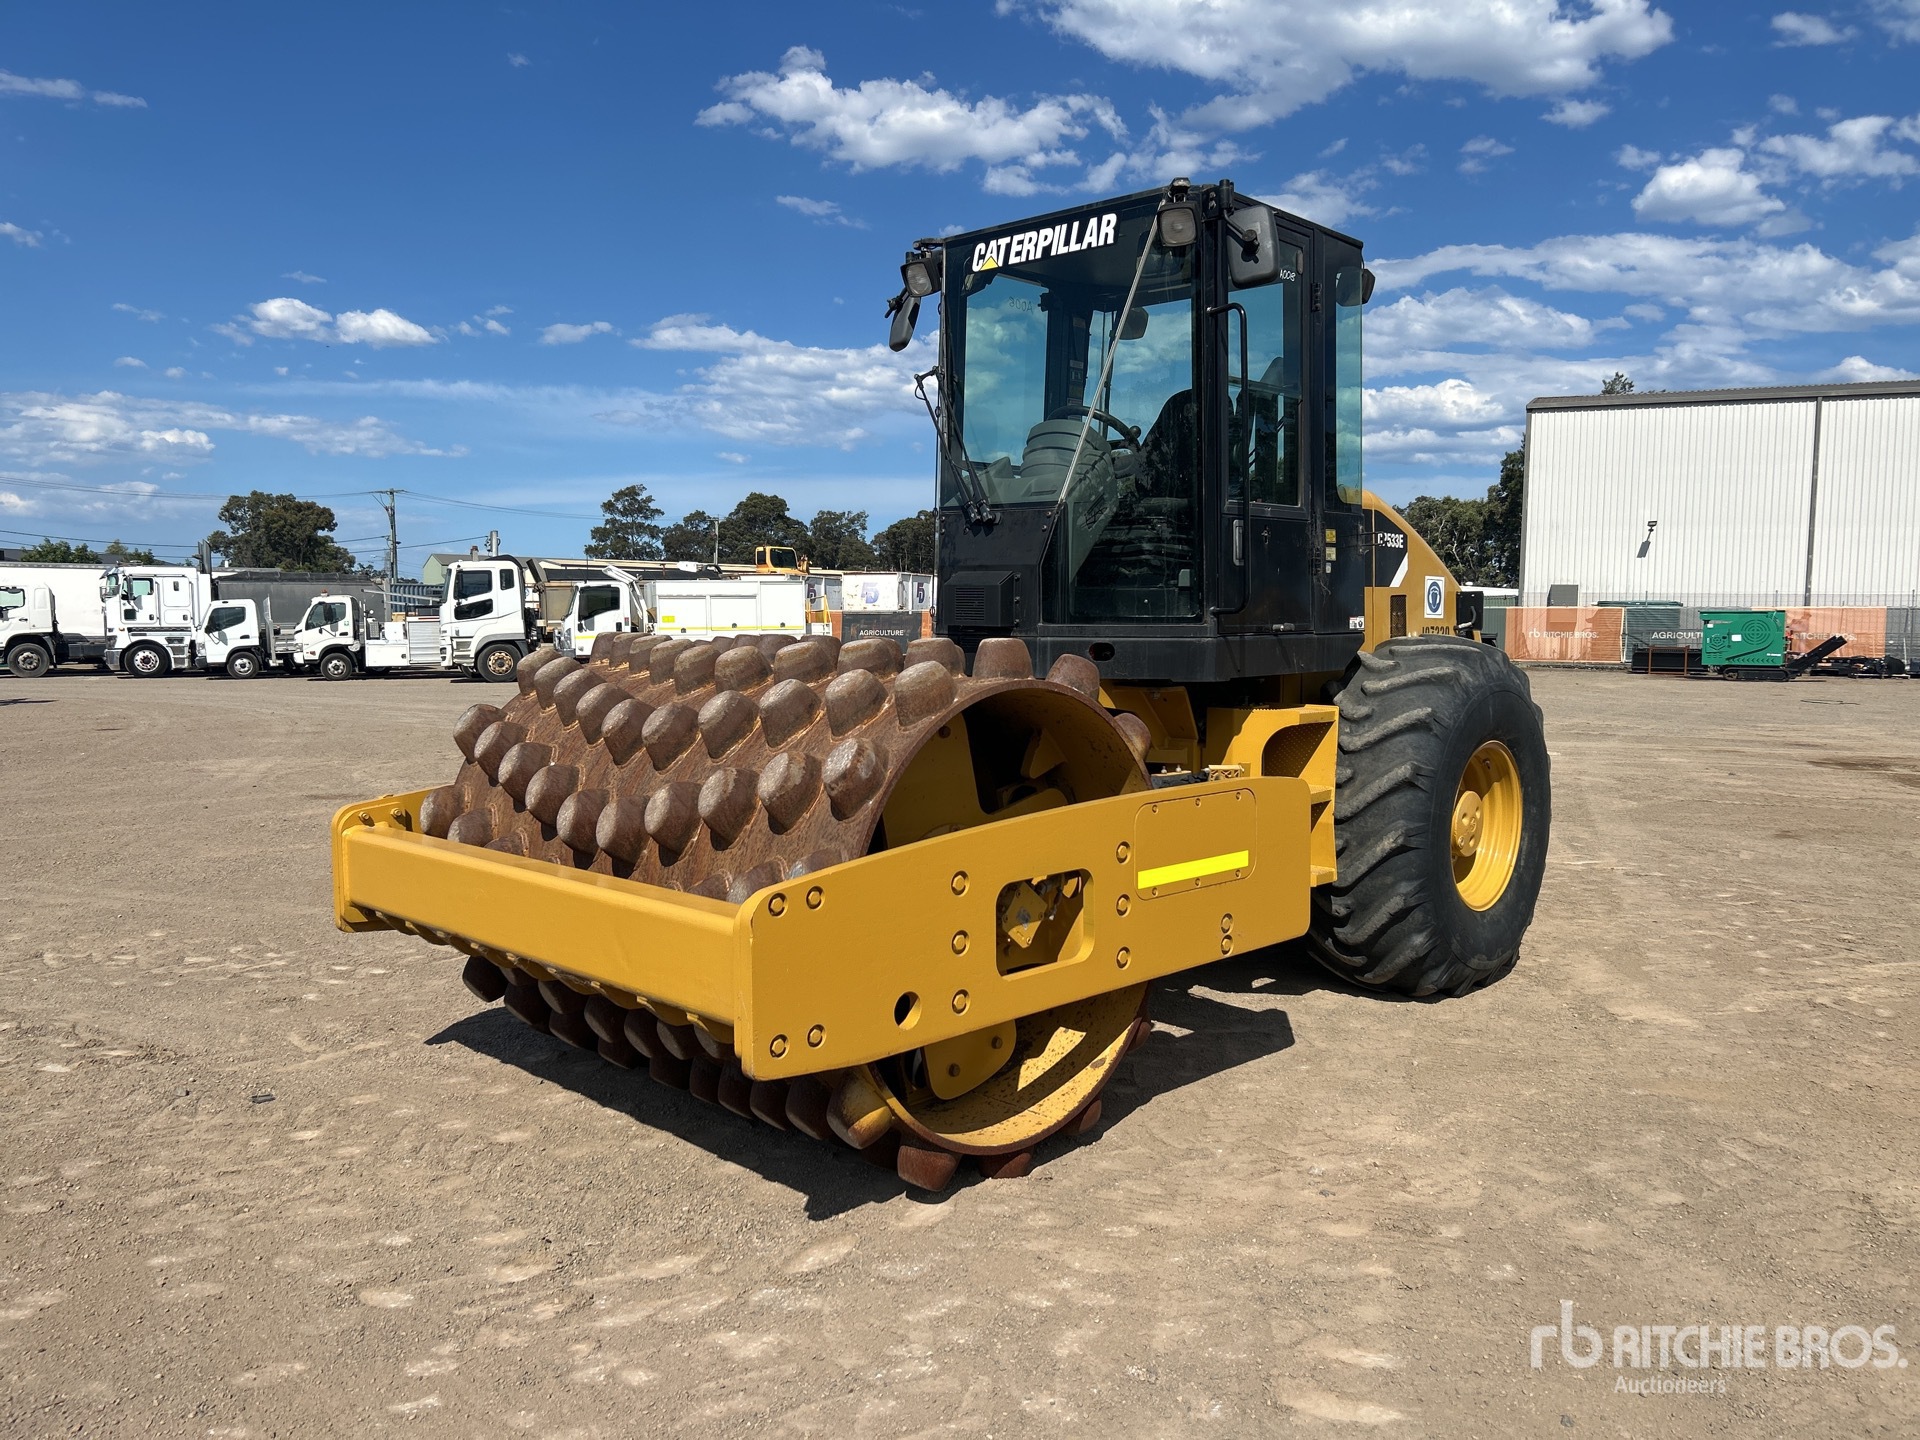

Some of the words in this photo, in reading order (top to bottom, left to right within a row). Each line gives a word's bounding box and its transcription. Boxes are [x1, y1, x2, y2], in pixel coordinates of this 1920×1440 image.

[972, 213, 1118, 272] CATERPILLAR
[1528, 628, 1541, 639] rb
[1543, 631, 1573, 639] RITCHIE
